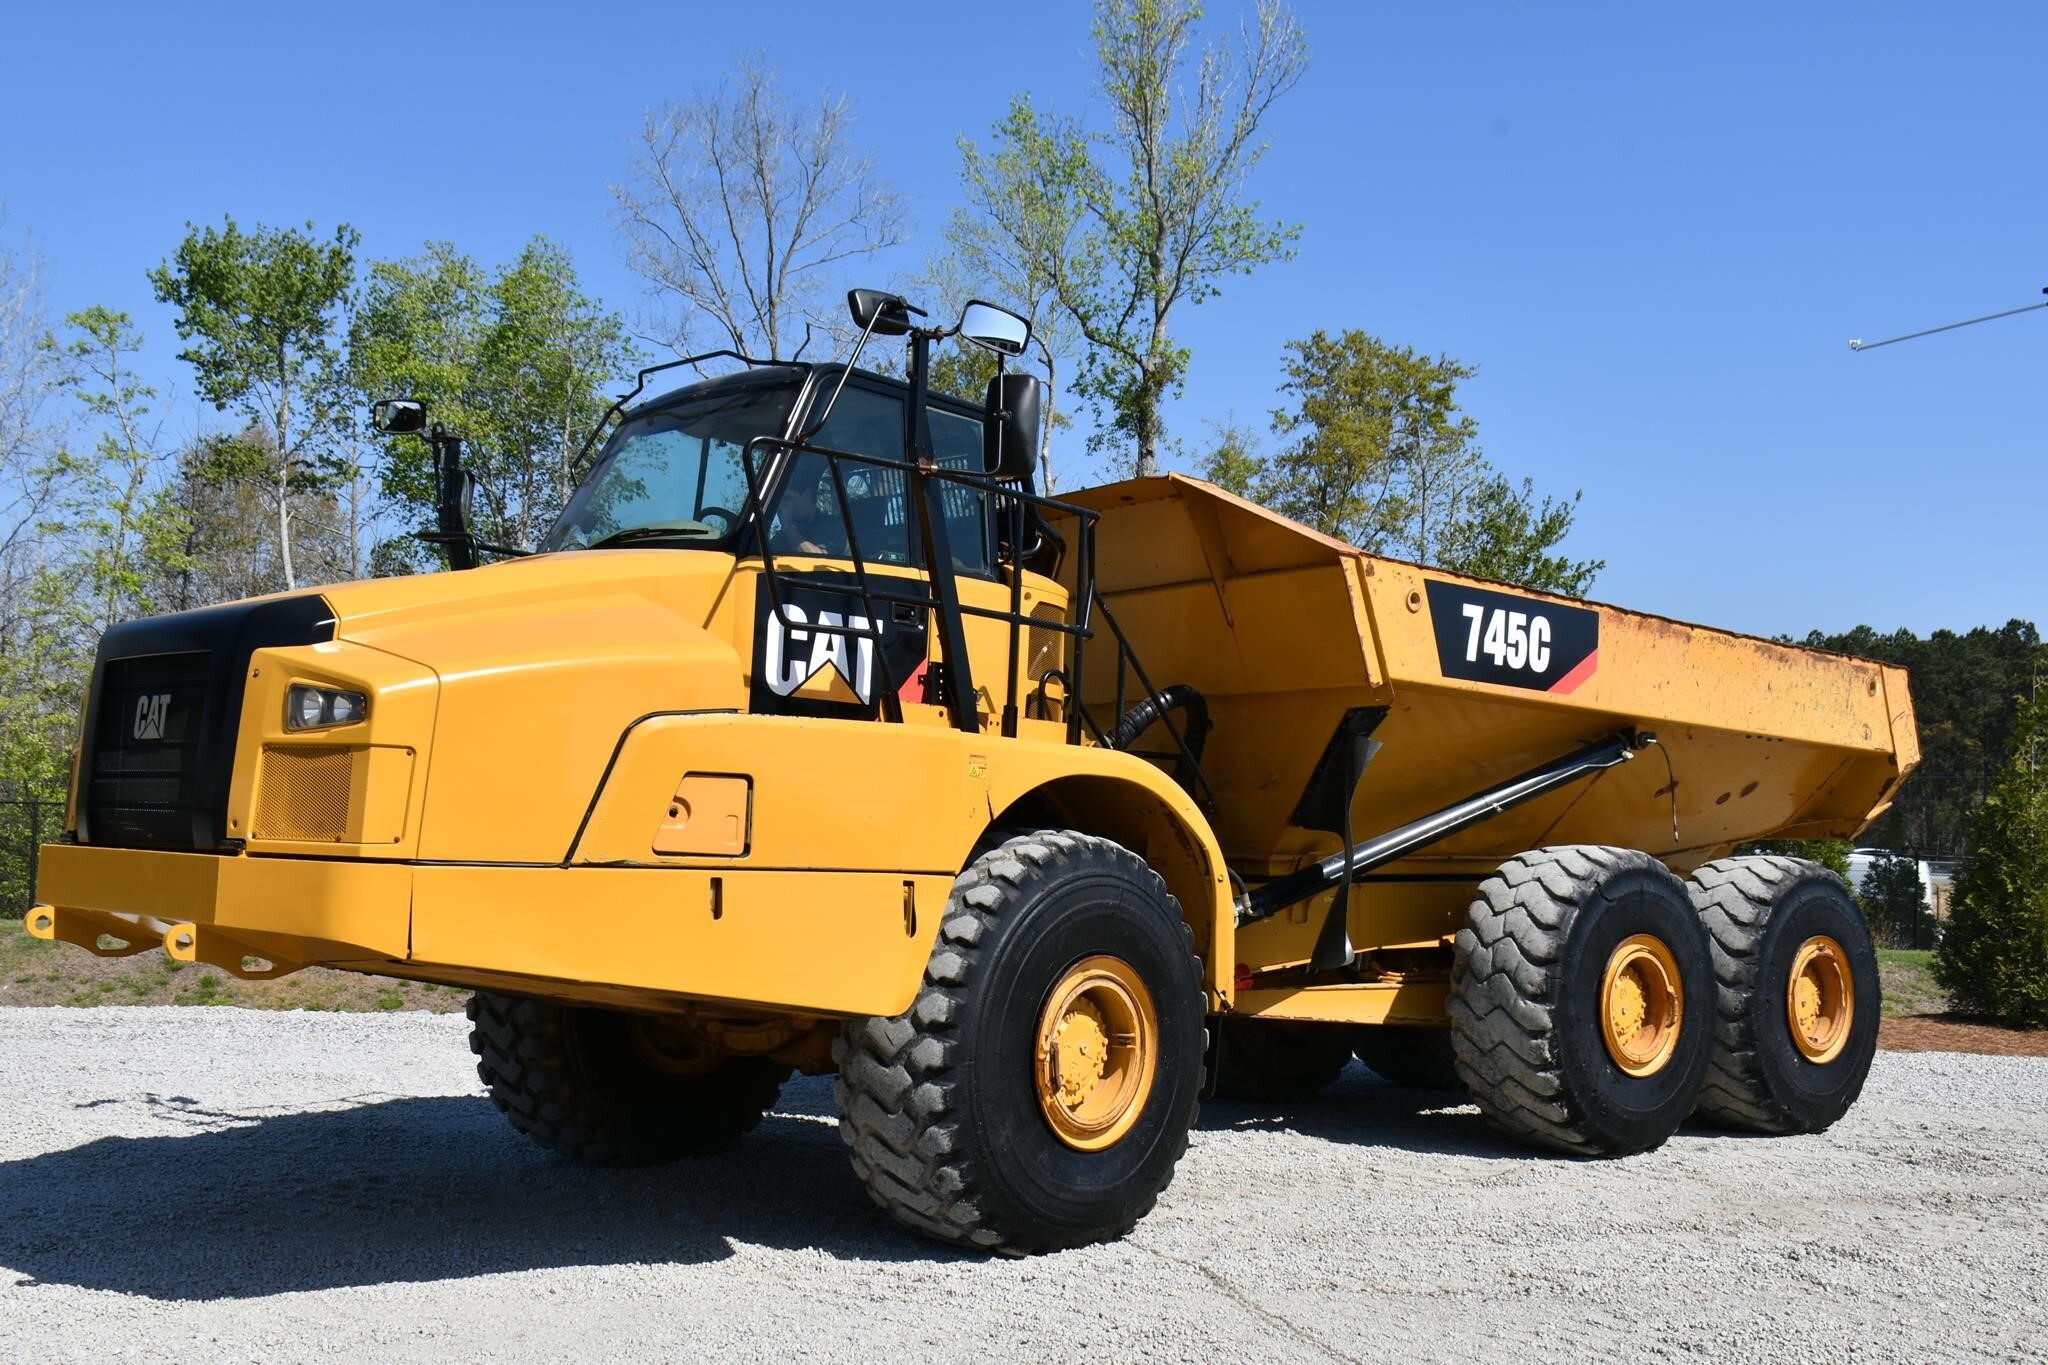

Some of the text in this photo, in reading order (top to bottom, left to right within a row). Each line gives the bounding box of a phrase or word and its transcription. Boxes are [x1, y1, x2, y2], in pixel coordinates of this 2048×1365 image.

[765, 604, 884, 706] CAT
[1462, 603, 1551, 673] 745C
[133, 694, 172, 740] CAT
